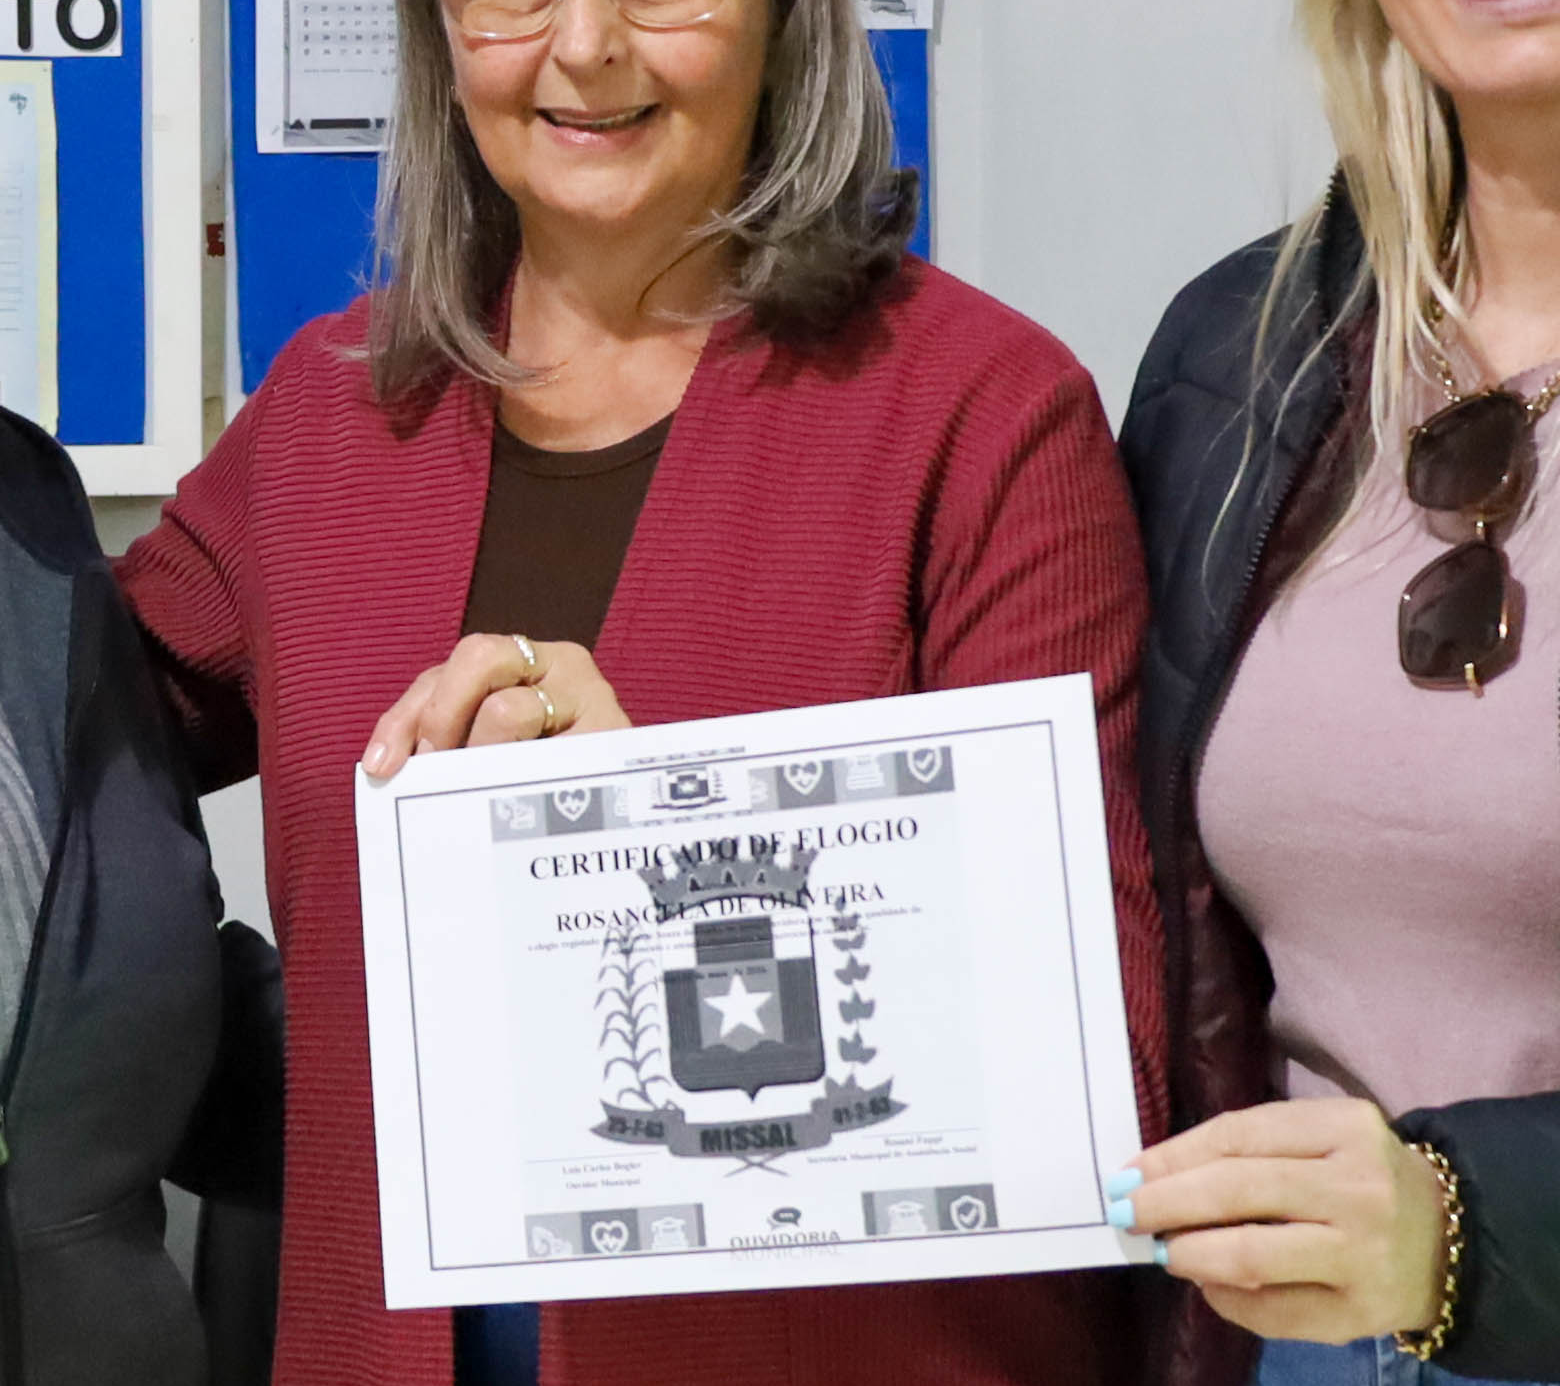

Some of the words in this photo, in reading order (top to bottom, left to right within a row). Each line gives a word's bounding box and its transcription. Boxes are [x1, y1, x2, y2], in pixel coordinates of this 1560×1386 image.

[529, 837, 739, 880] CERTIFICADO
[747, 833, 787, 858] DE
[718, 896, 752, 917] DE
[699, 1122, 797, 1153] MISSAL
